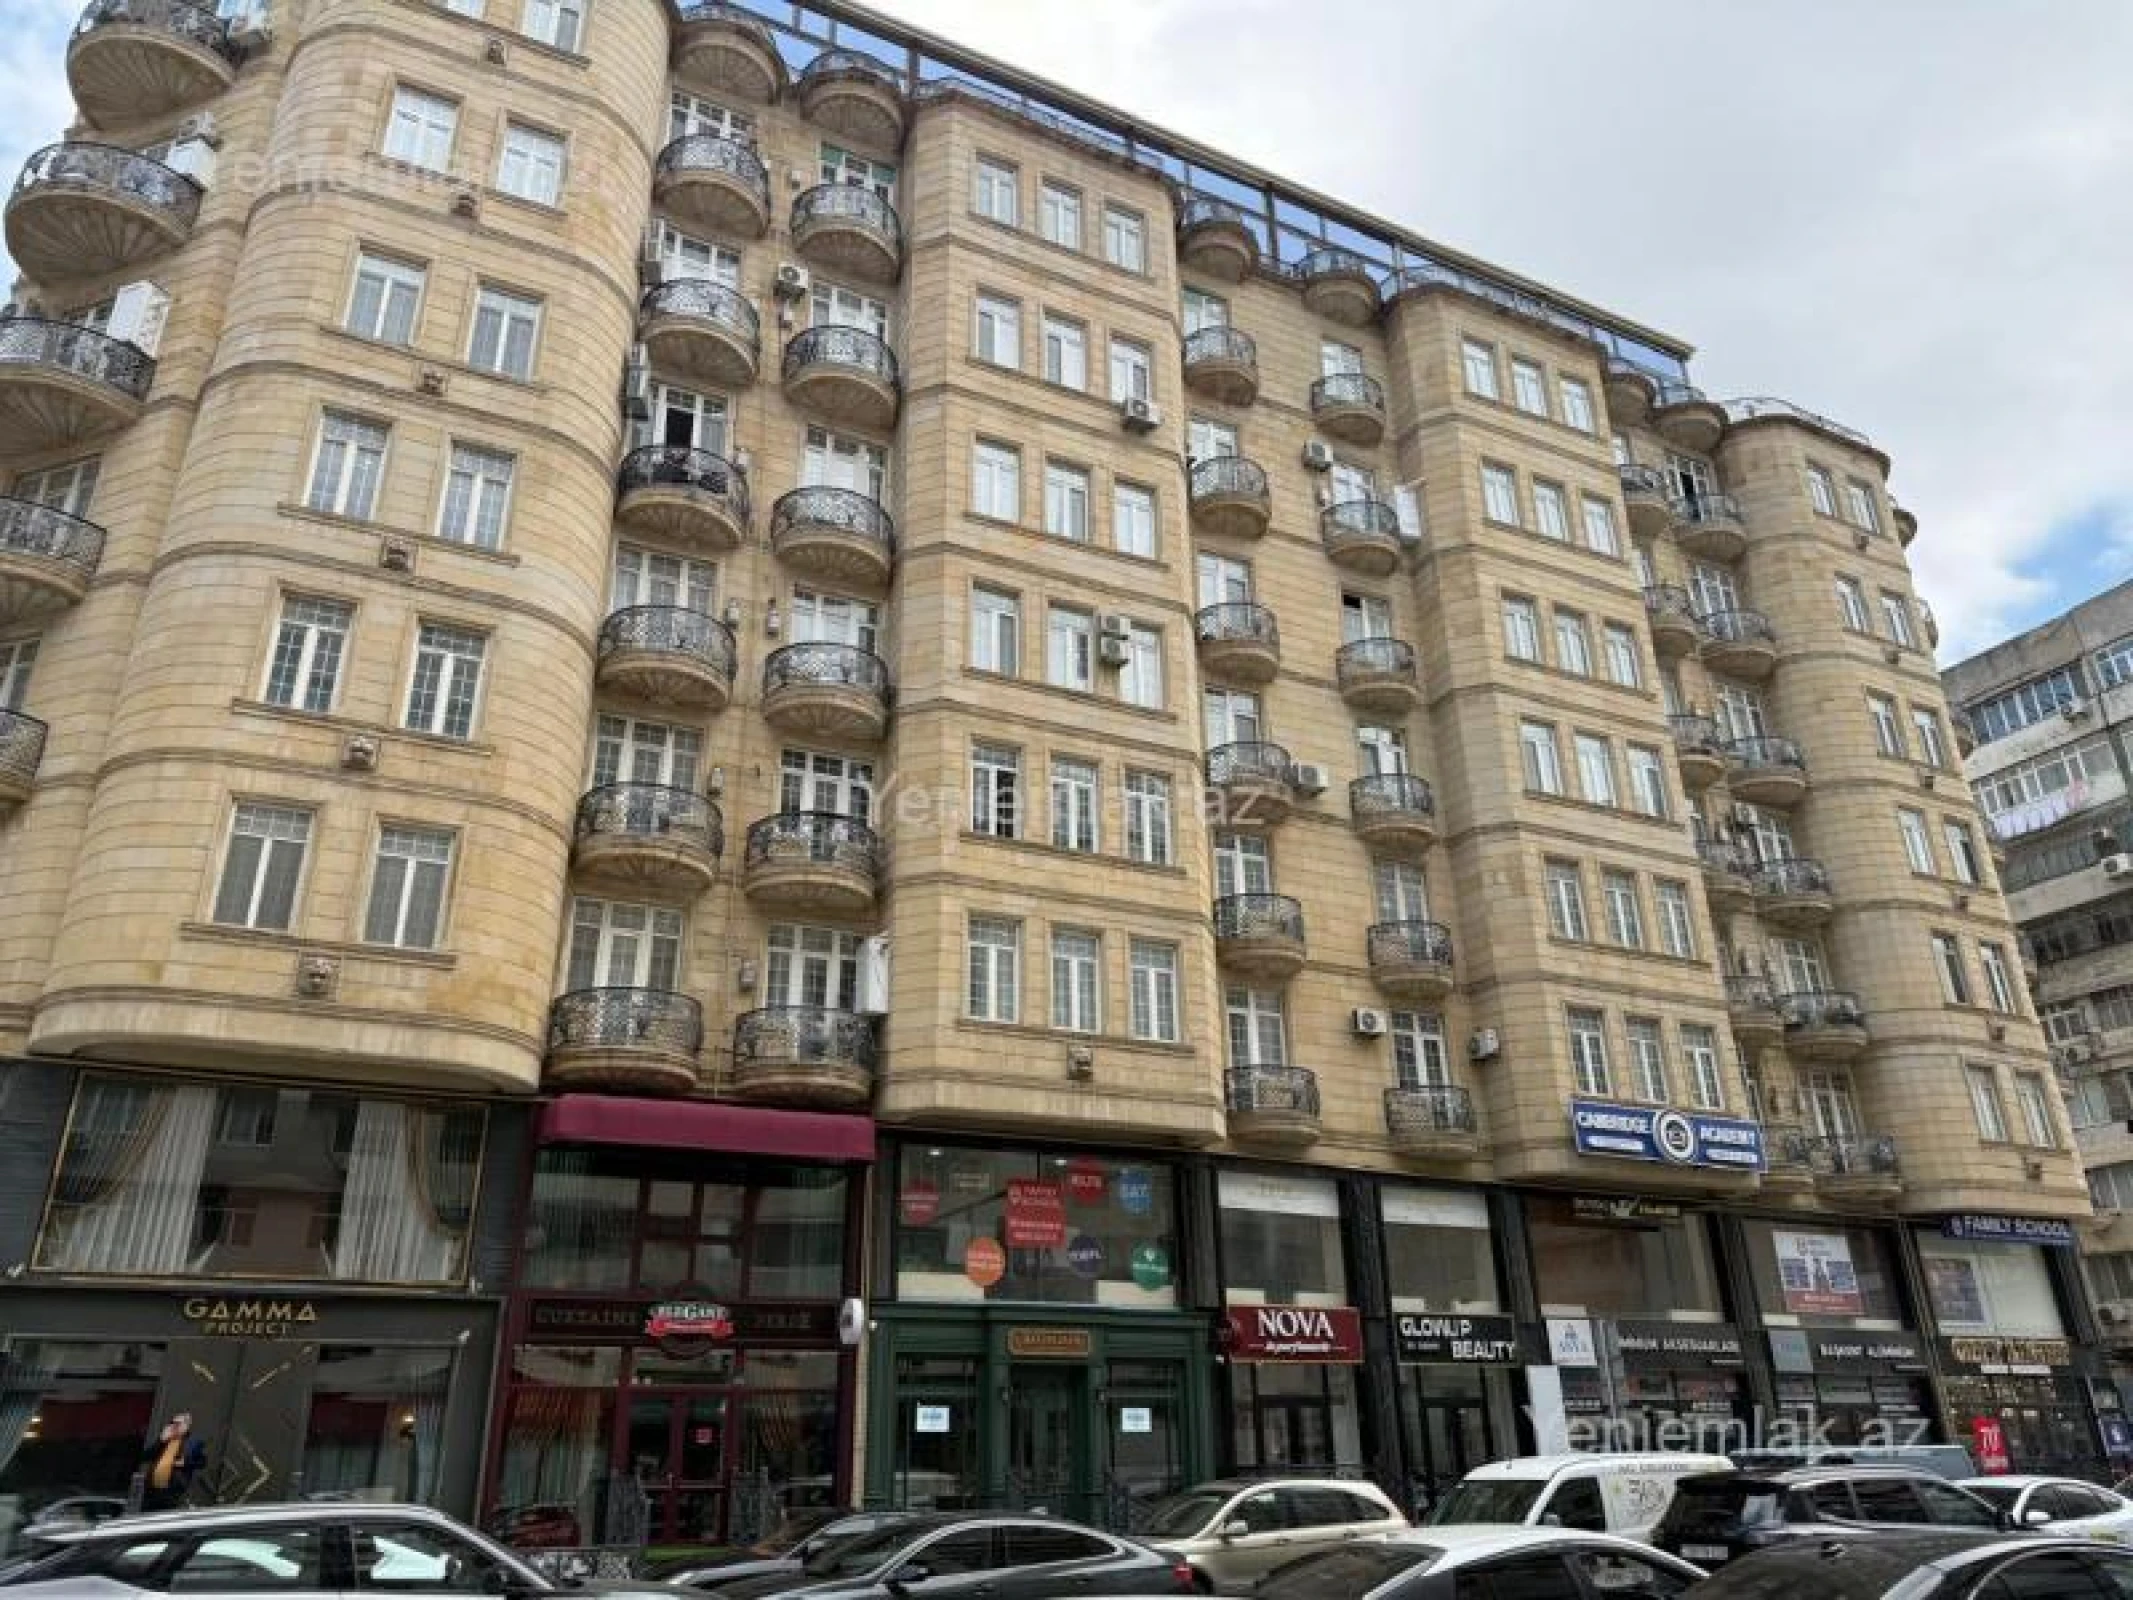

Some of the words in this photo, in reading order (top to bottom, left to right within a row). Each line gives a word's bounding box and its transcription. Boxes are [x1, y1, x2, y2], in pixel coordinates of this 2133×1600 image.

[184, 1299, 317, 1321] GAMMA
[1258, 1308, 1334, 1339] NOVA
[1452, 1340, 1516, 1360] BEAUTY
